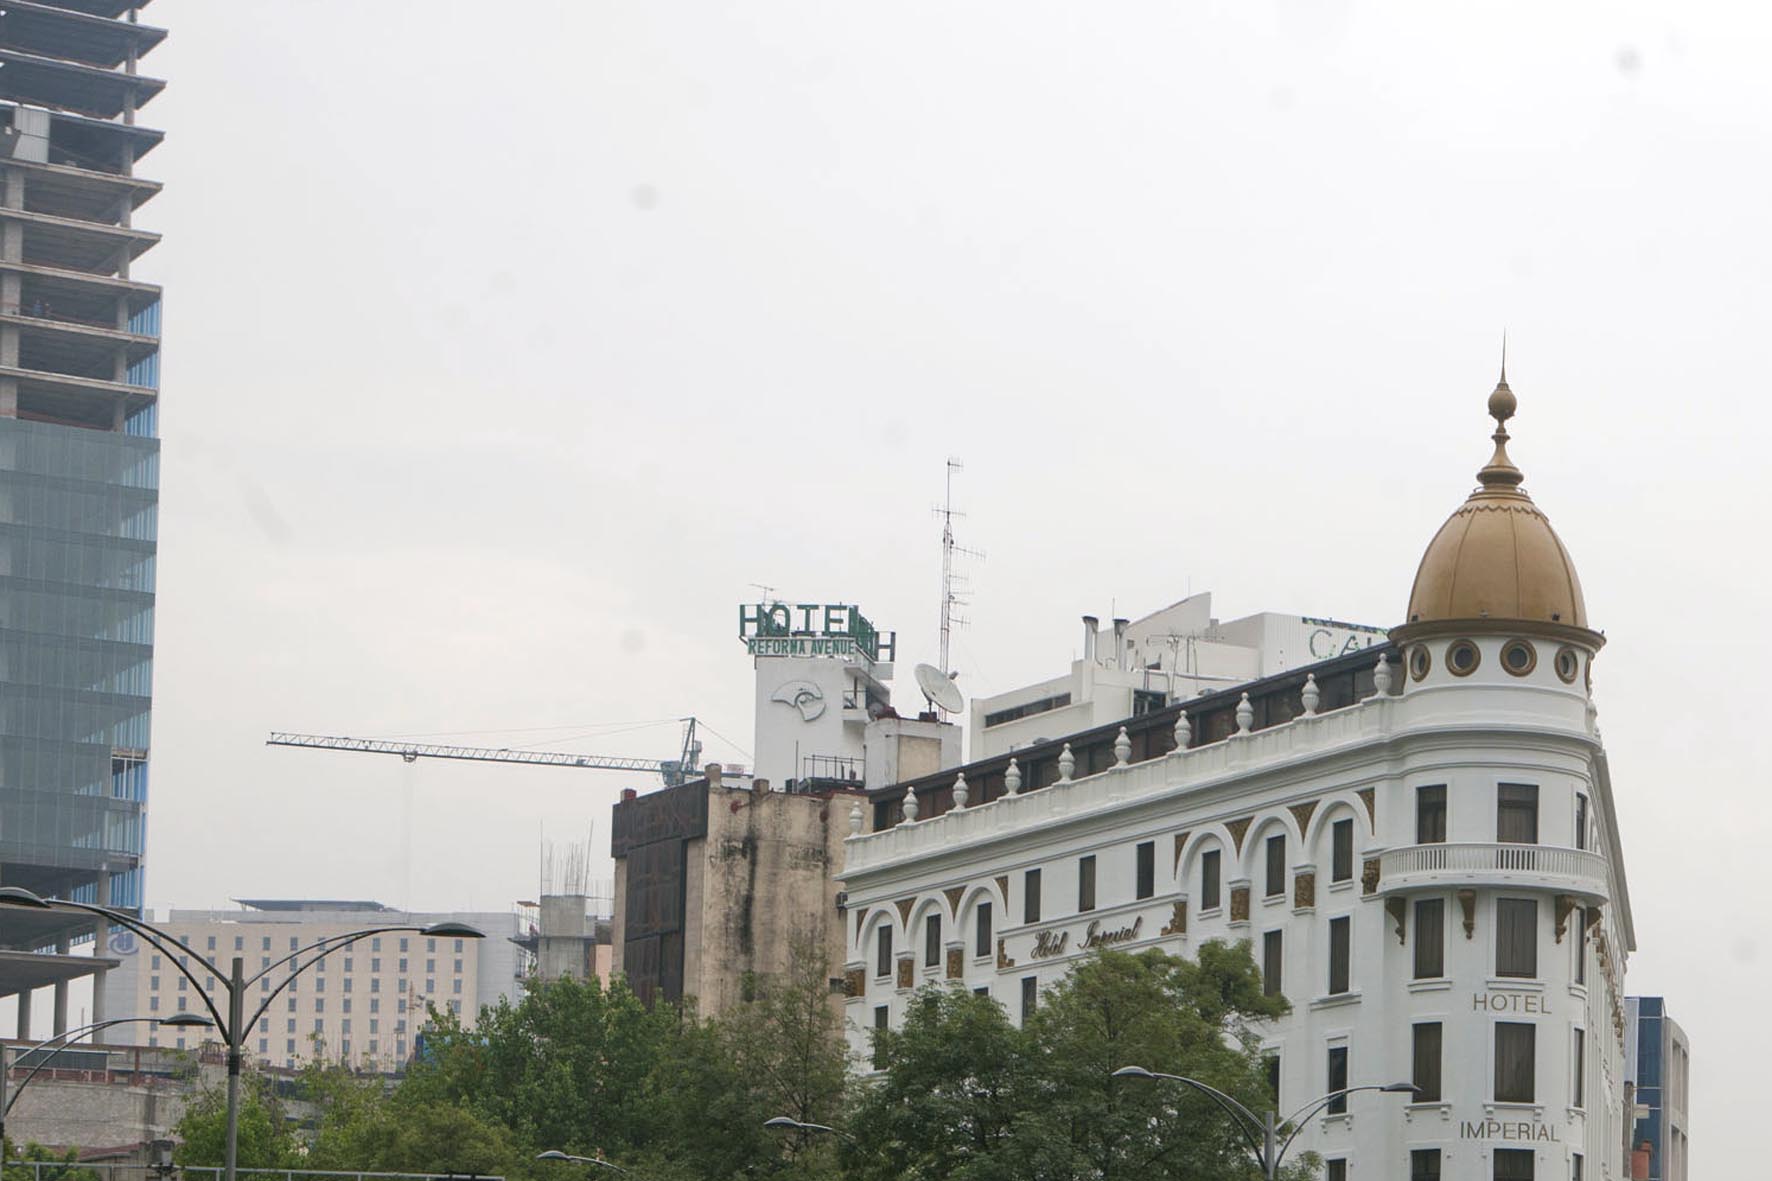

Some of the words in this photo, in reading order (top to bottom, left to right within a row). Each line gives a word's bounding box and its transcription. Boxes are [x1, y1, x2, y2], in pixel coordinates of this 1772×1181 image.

[740, 604, 858, 637] HOTEL
[748, 638, 806, 655] REFORMA
[811, 638, 856, 655] AVENUE
[1473, 993, 1552, 1015] HOTEL
[1460, 1121, 1560, 1143] IMPERIAL
